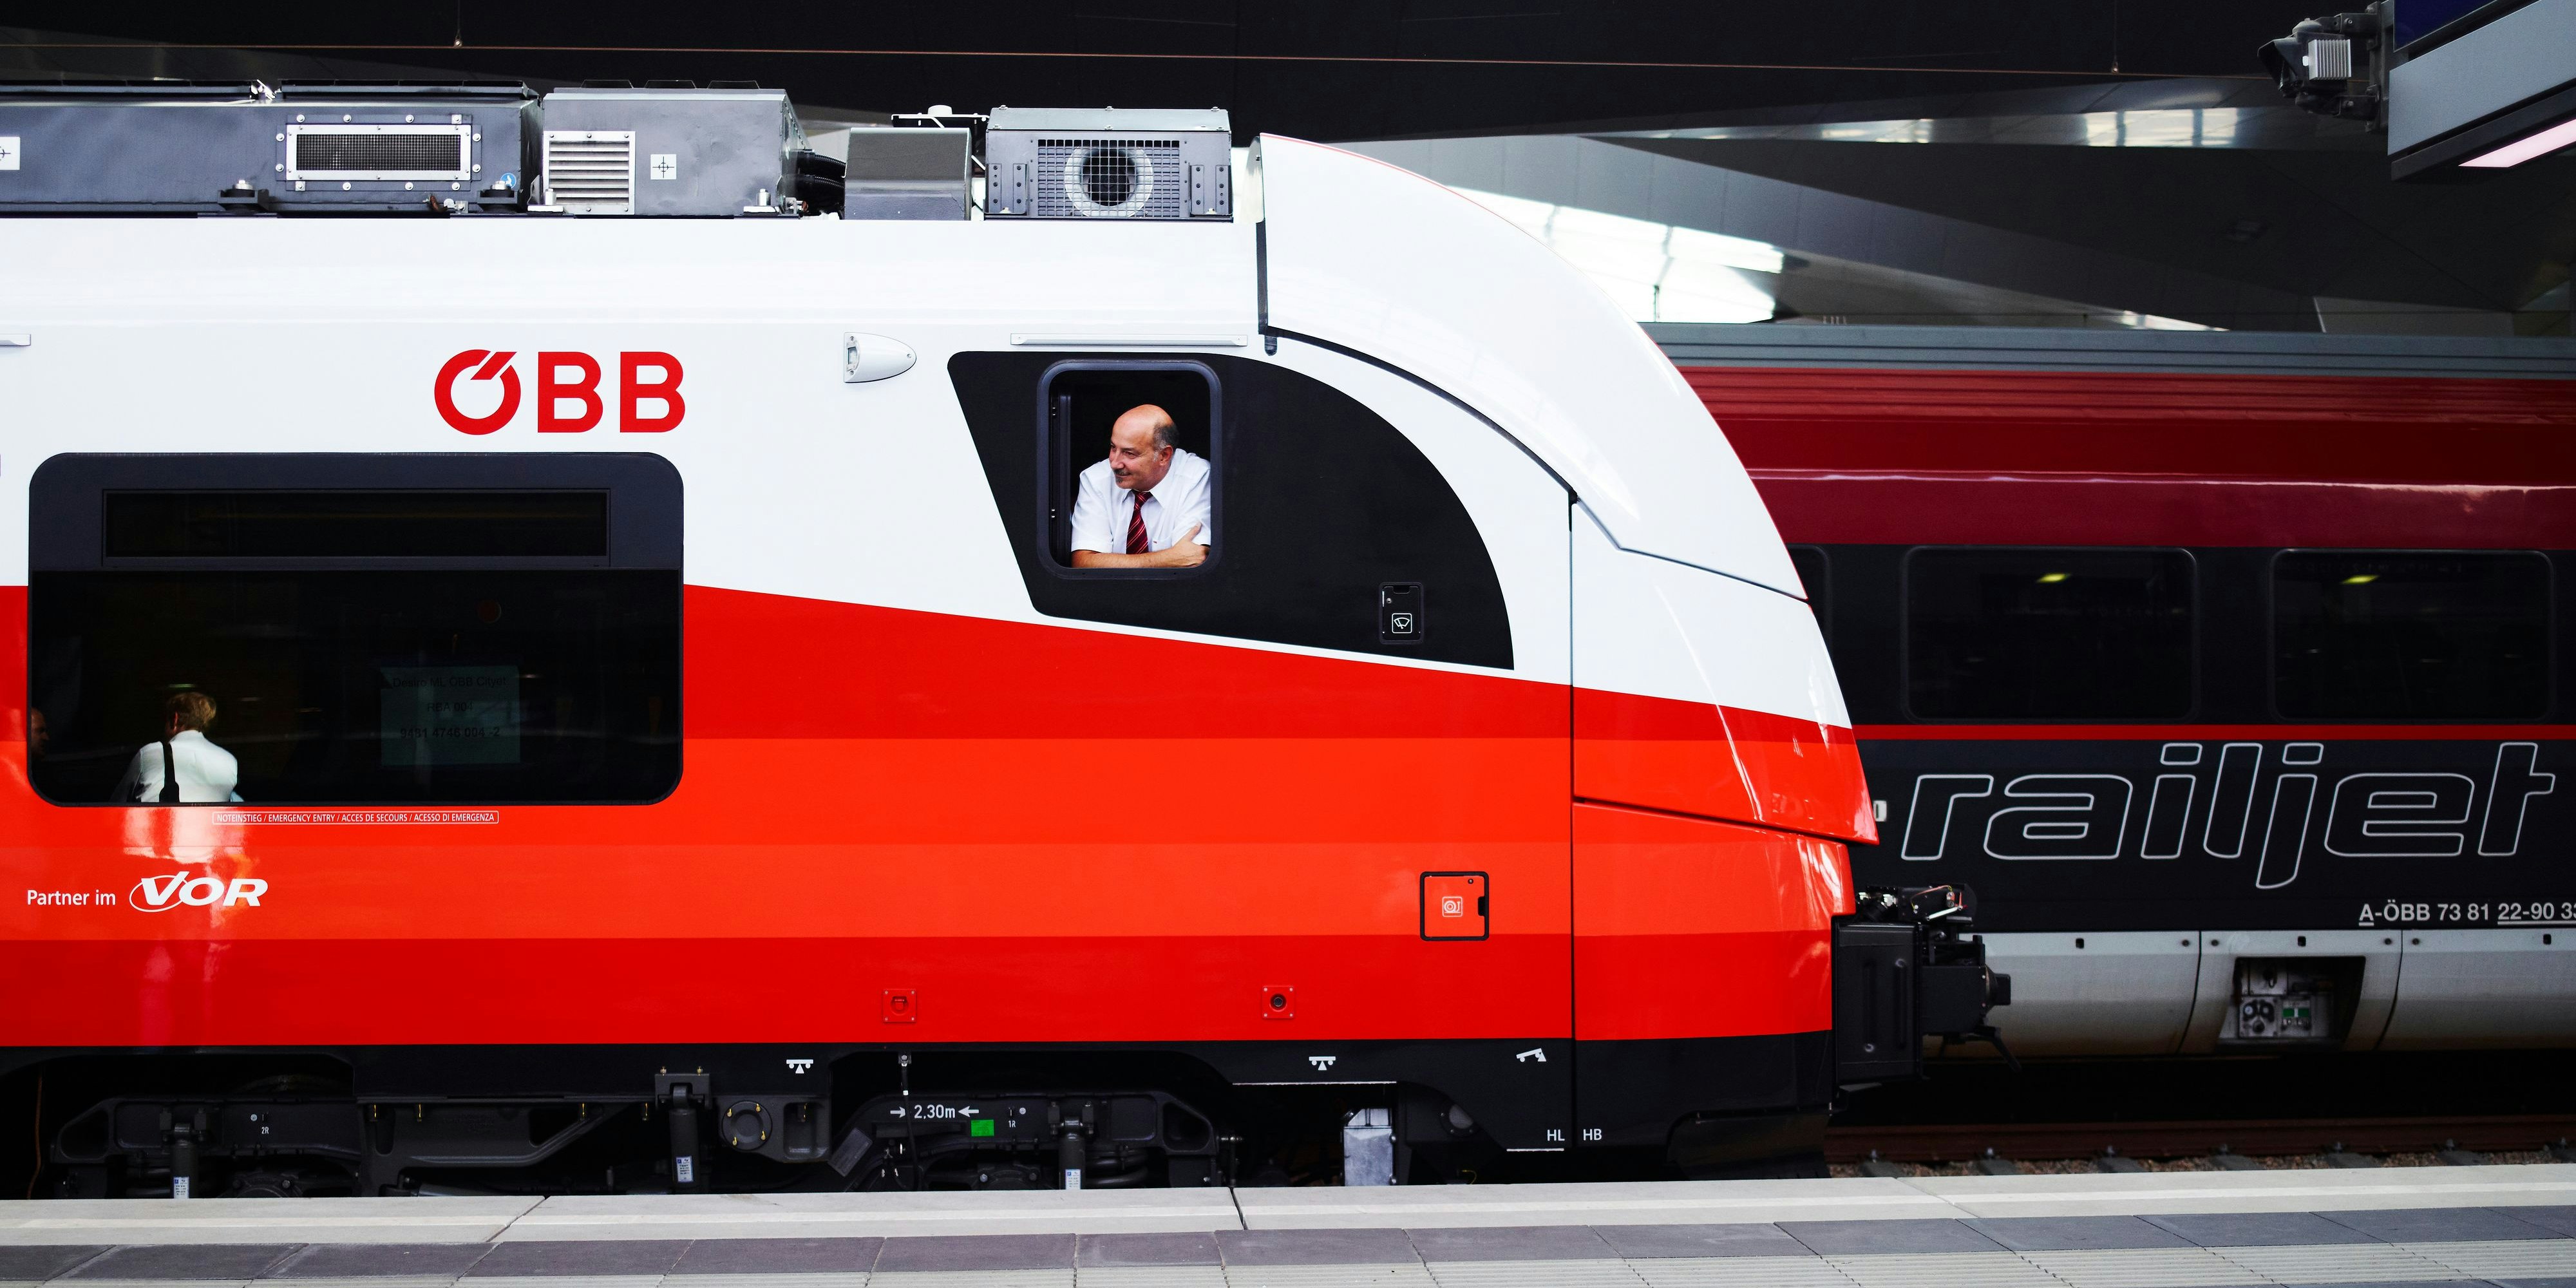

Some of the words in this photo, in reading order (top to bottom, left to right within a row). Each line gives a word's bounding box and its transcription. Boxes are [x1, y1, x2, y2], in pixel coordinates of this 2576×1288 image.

[434, 349, 685, 435] ÖBB
[393, 677, 427, 687] Desiro
[430, 677, 446, 687] ML
[427, 702, 451, 712] RBA
[454, 701, 473, 712] 004
[432, 728, 461, 738] 4746
[217, 813, 262, 822] NOTEINSTIEG
[269, 813, 311, 822] EMERGENCY
[313, 813, 335, 822] ENTRY
[341, 813, 363, 822] ACCES
[365, 813, 374, 822] DE
[376, 813, 408, 822] SECOURS
[413, 813, 440, 822] ACESSO
[442, 813, 450, 822] DI
[451, 813, 495, 822] EMERGENZA
[1901, 743, 2555, 889] railjet
[27, 889, 90, 905] Partner
[95, 889, 116, 905] im
[140, 871, 269, 907] VOR
[2359, 899, 2430, 921] A-ÖBB
[2438, 904, 2461, 921] 73
[2467, 904, 2489, 921] 81
[2497, 903, 2555, 921] 22-90
[2561, 902, 2576, 920] 3
[914, 1104, 955, 1119] 2,30m
[261, 1126, 269, 1135] 2R
[1547, 1129, 1565, 1141] HL
[1583, 1128, 1602, 1141] HB
